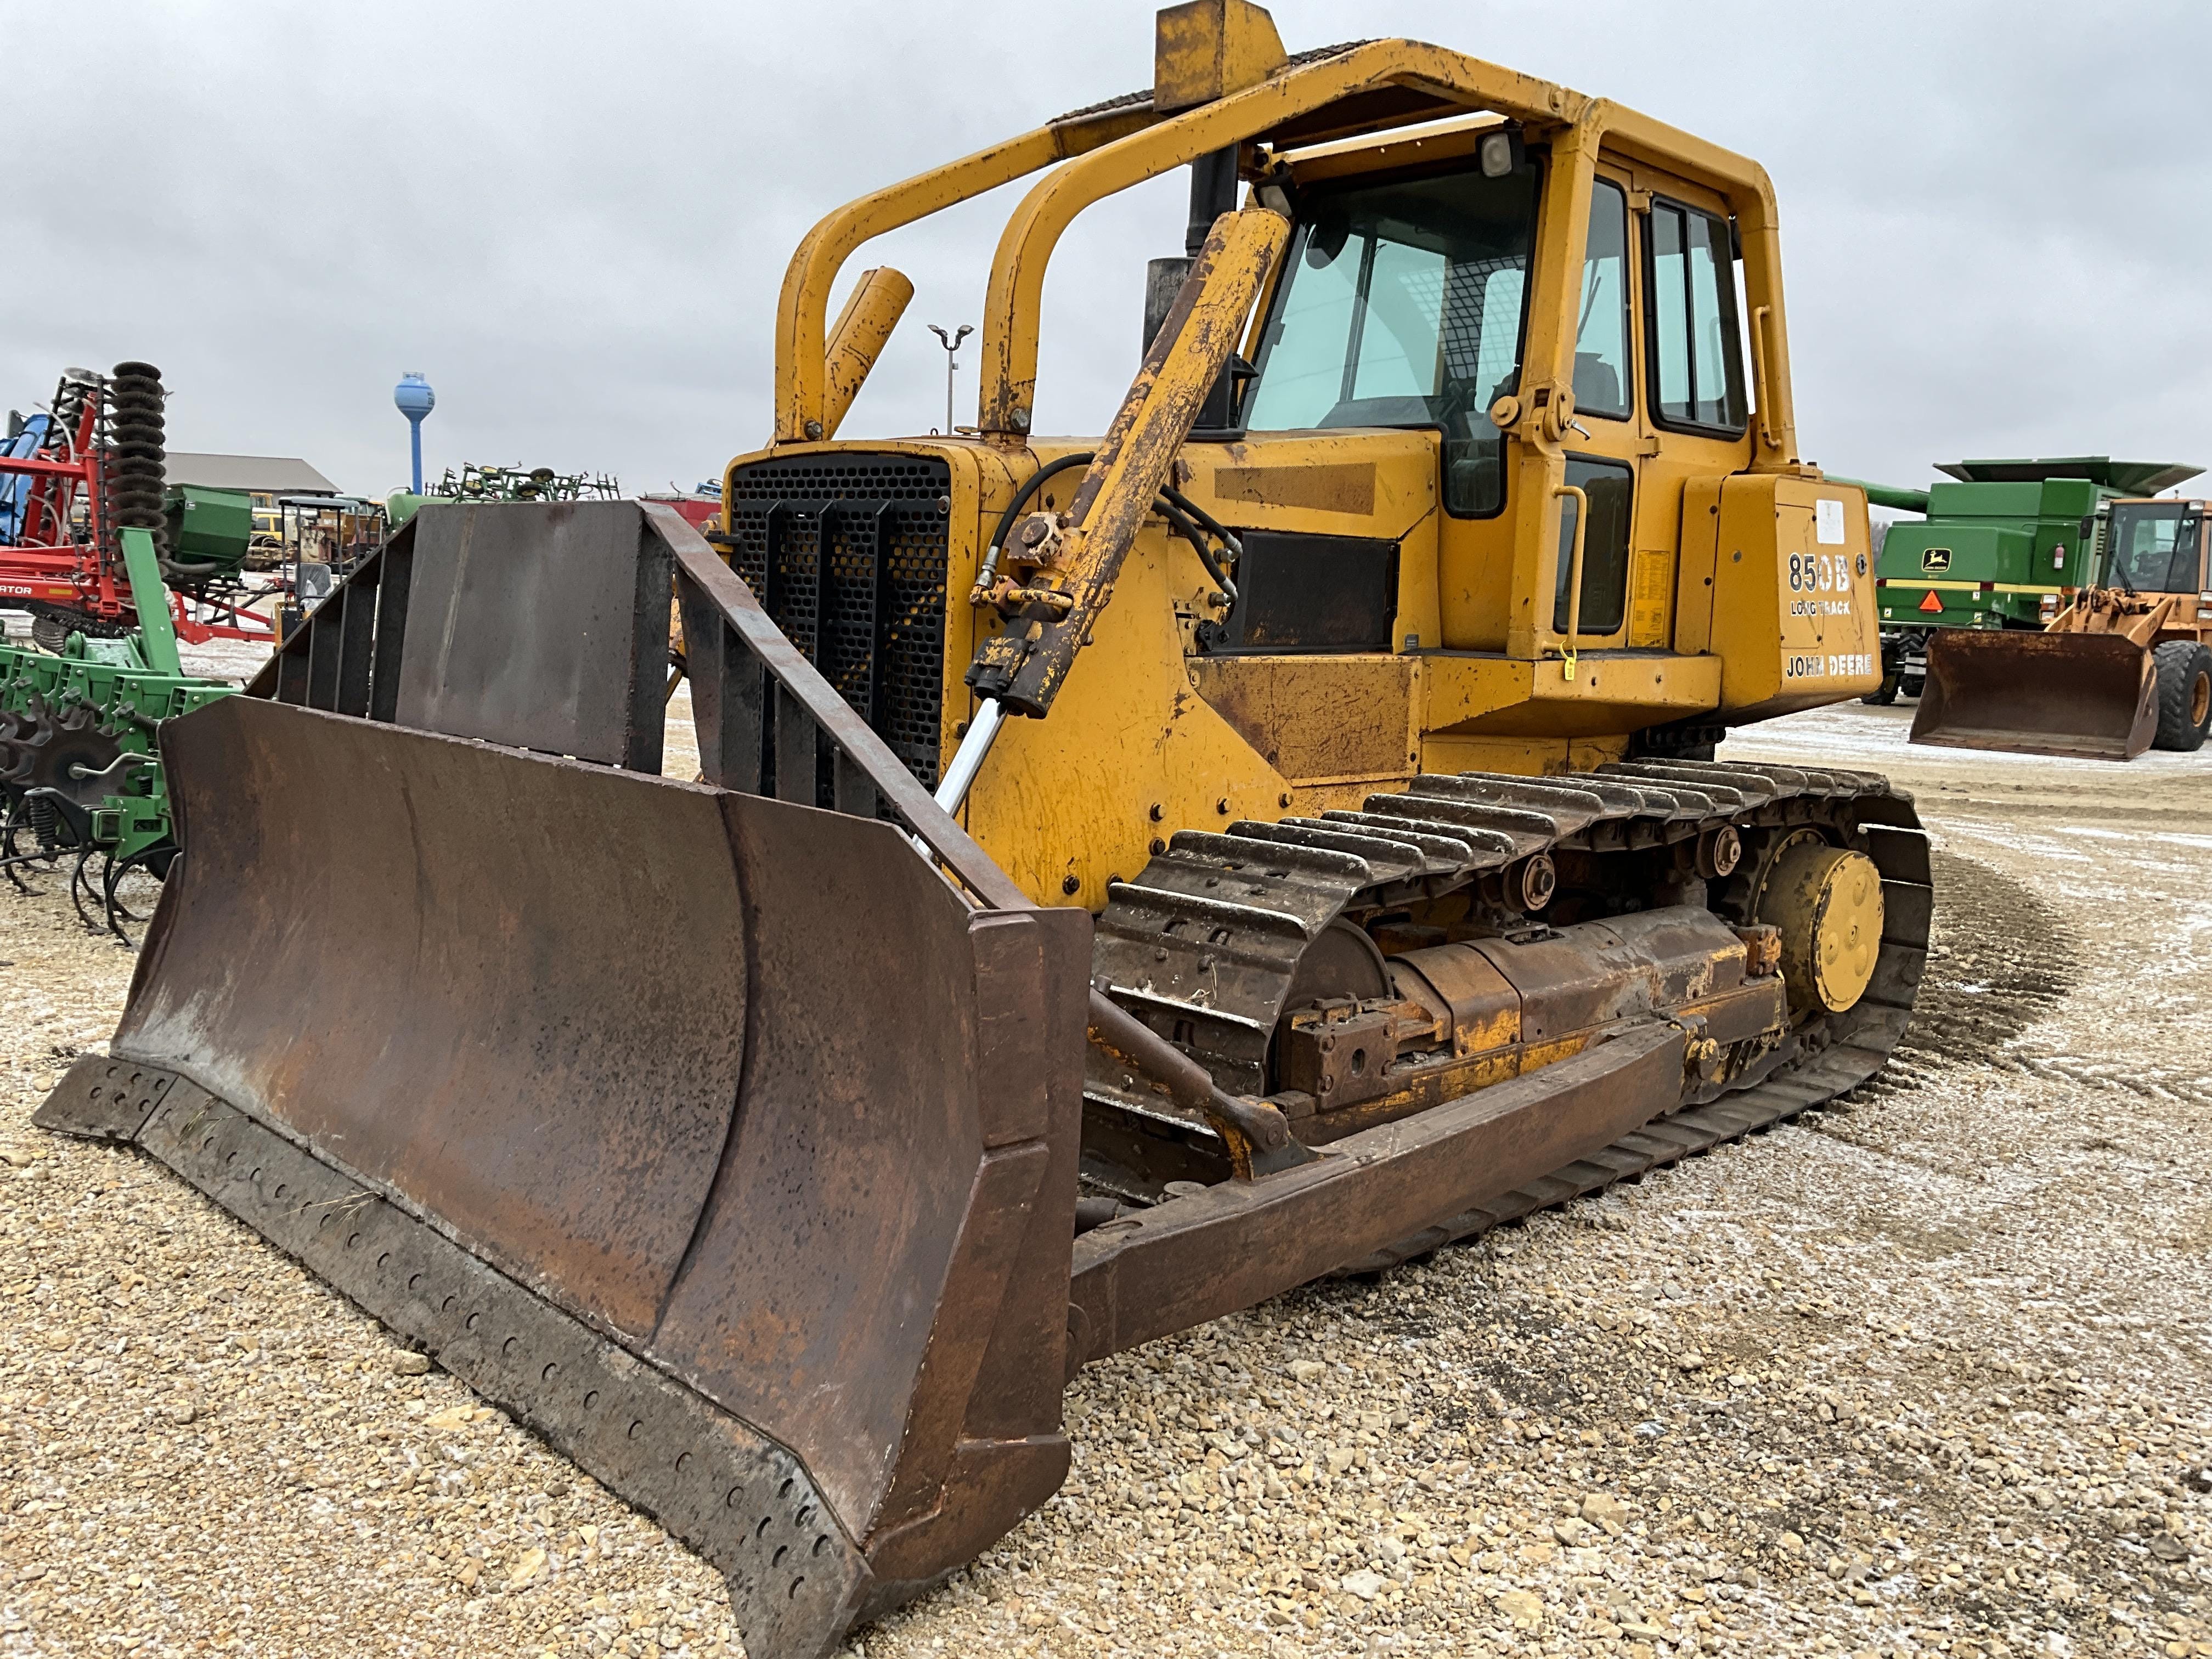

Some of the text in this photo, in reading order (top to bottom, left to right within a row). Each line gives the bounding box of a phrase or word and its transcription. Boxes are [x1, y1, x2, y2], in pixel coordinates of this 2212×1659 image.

[1791, 600, 1850, 616] LONG TRACK
[1787, 654, 1872, 679] JOHN DEERE
